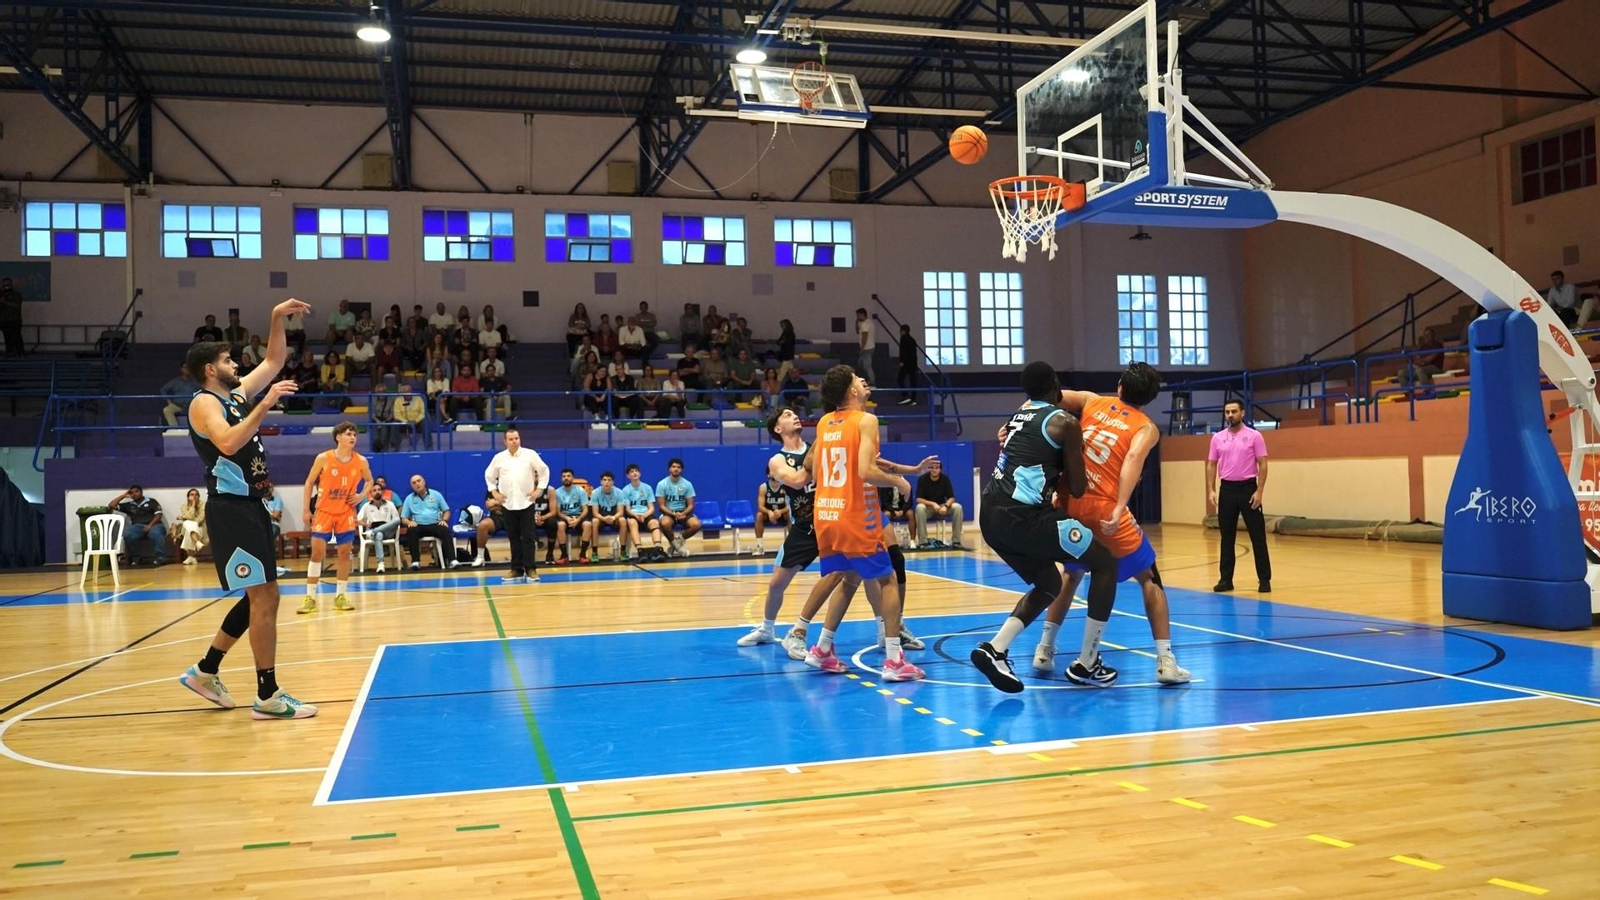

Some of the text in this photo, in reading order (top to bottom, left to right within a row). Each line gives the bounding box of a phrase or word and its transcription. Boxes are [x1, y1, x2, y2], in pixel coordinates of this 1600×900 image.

[821, 447, 848, 488] 13
[1486, 496, 1537, 518] IBERO
[1486, 517, 1537, 525] SPORT
